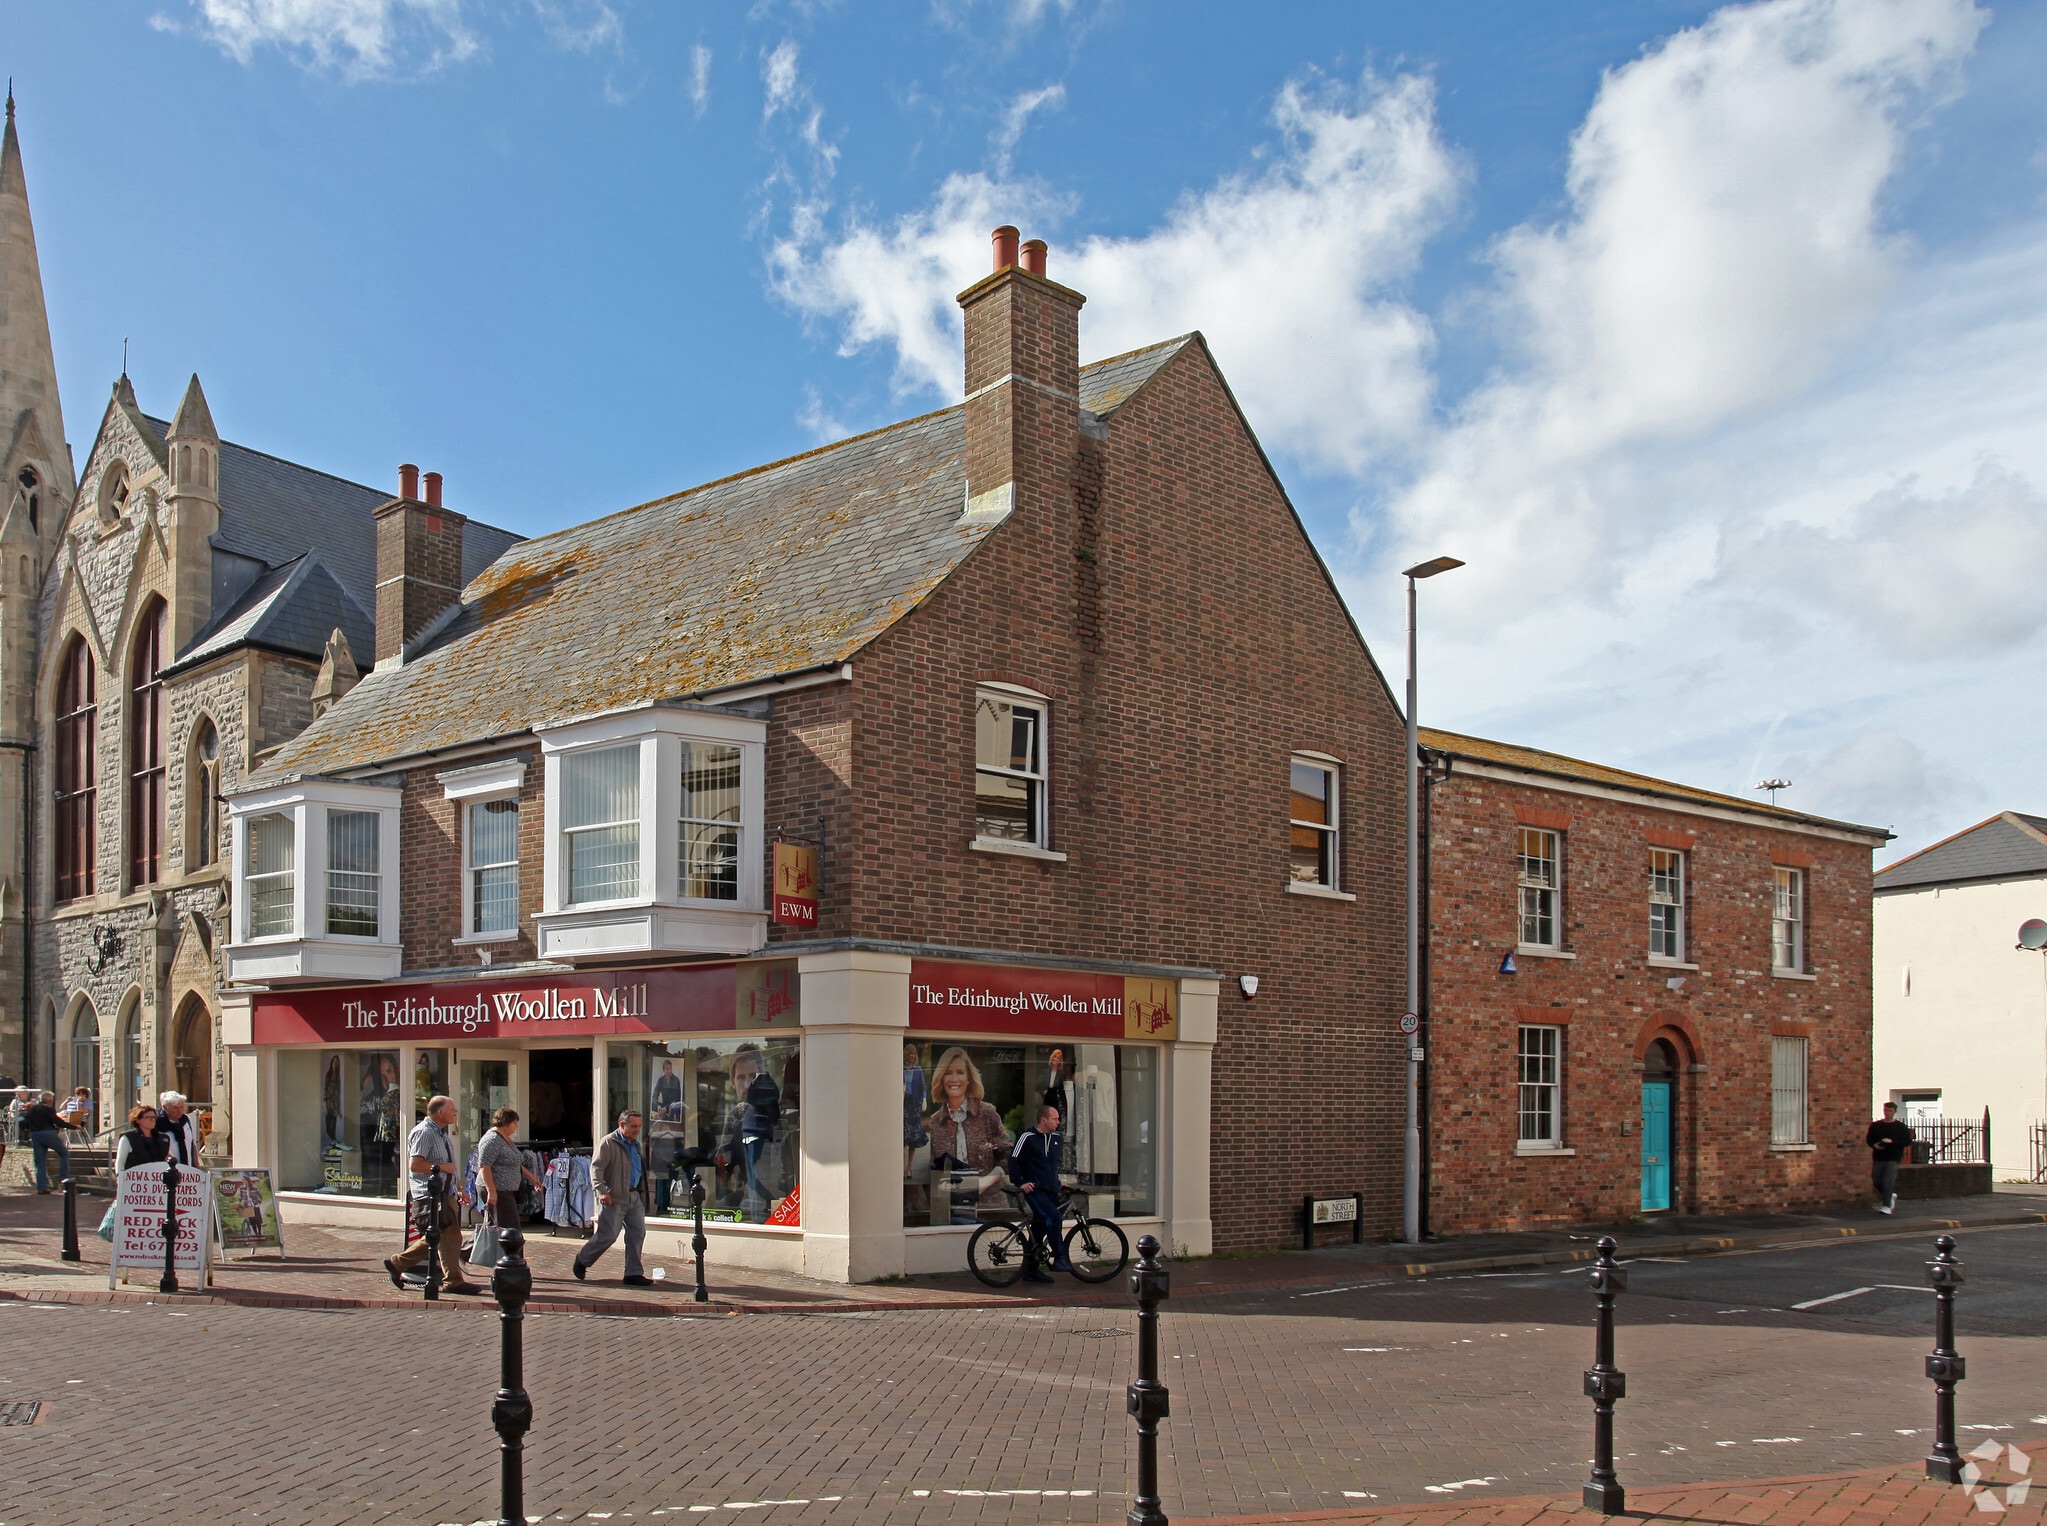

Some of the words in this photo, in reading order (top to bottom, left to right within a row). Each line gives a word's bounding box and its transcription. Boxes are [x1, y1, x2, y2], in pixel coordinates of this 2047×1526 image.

[780, 902, 814, 920] EWM
[912, 984, 944, 1005] The
[947, 987, 1029, 1015] Edinburgh
[1030, 992, 1088, 1014] Woollen
[1091, 997, 1122, 1016] Mill
[342, 1000, 379, 1029] The
[382, 993, 491, 1033] Edinburgh
[492, 987, 587, 1022] Woollen
[592, 982, 649, 1018] Mill
[1403, 1016, 1416, 1026] 20
[126, 1171, 143, 1181] NEW
[144, 1172, 150, 1181] &
[177, 1185, 197, 1195] TAPES
[123, 1195, 156, 1206] POSTERS
[158, 1196, 165, 1206] &
[774, 1190, 800, 1223] SALE
[1332, 1201, 1355, 1212] NORTH
[1331, 1210, 1355, 1220] STREET
[123, 1216, 152, 1227] RED
[157, 1217, 197, 1228] RCK
[127, 1228, 196, 1240] RECODS
[148, 1241, 199, 1252] 67793
